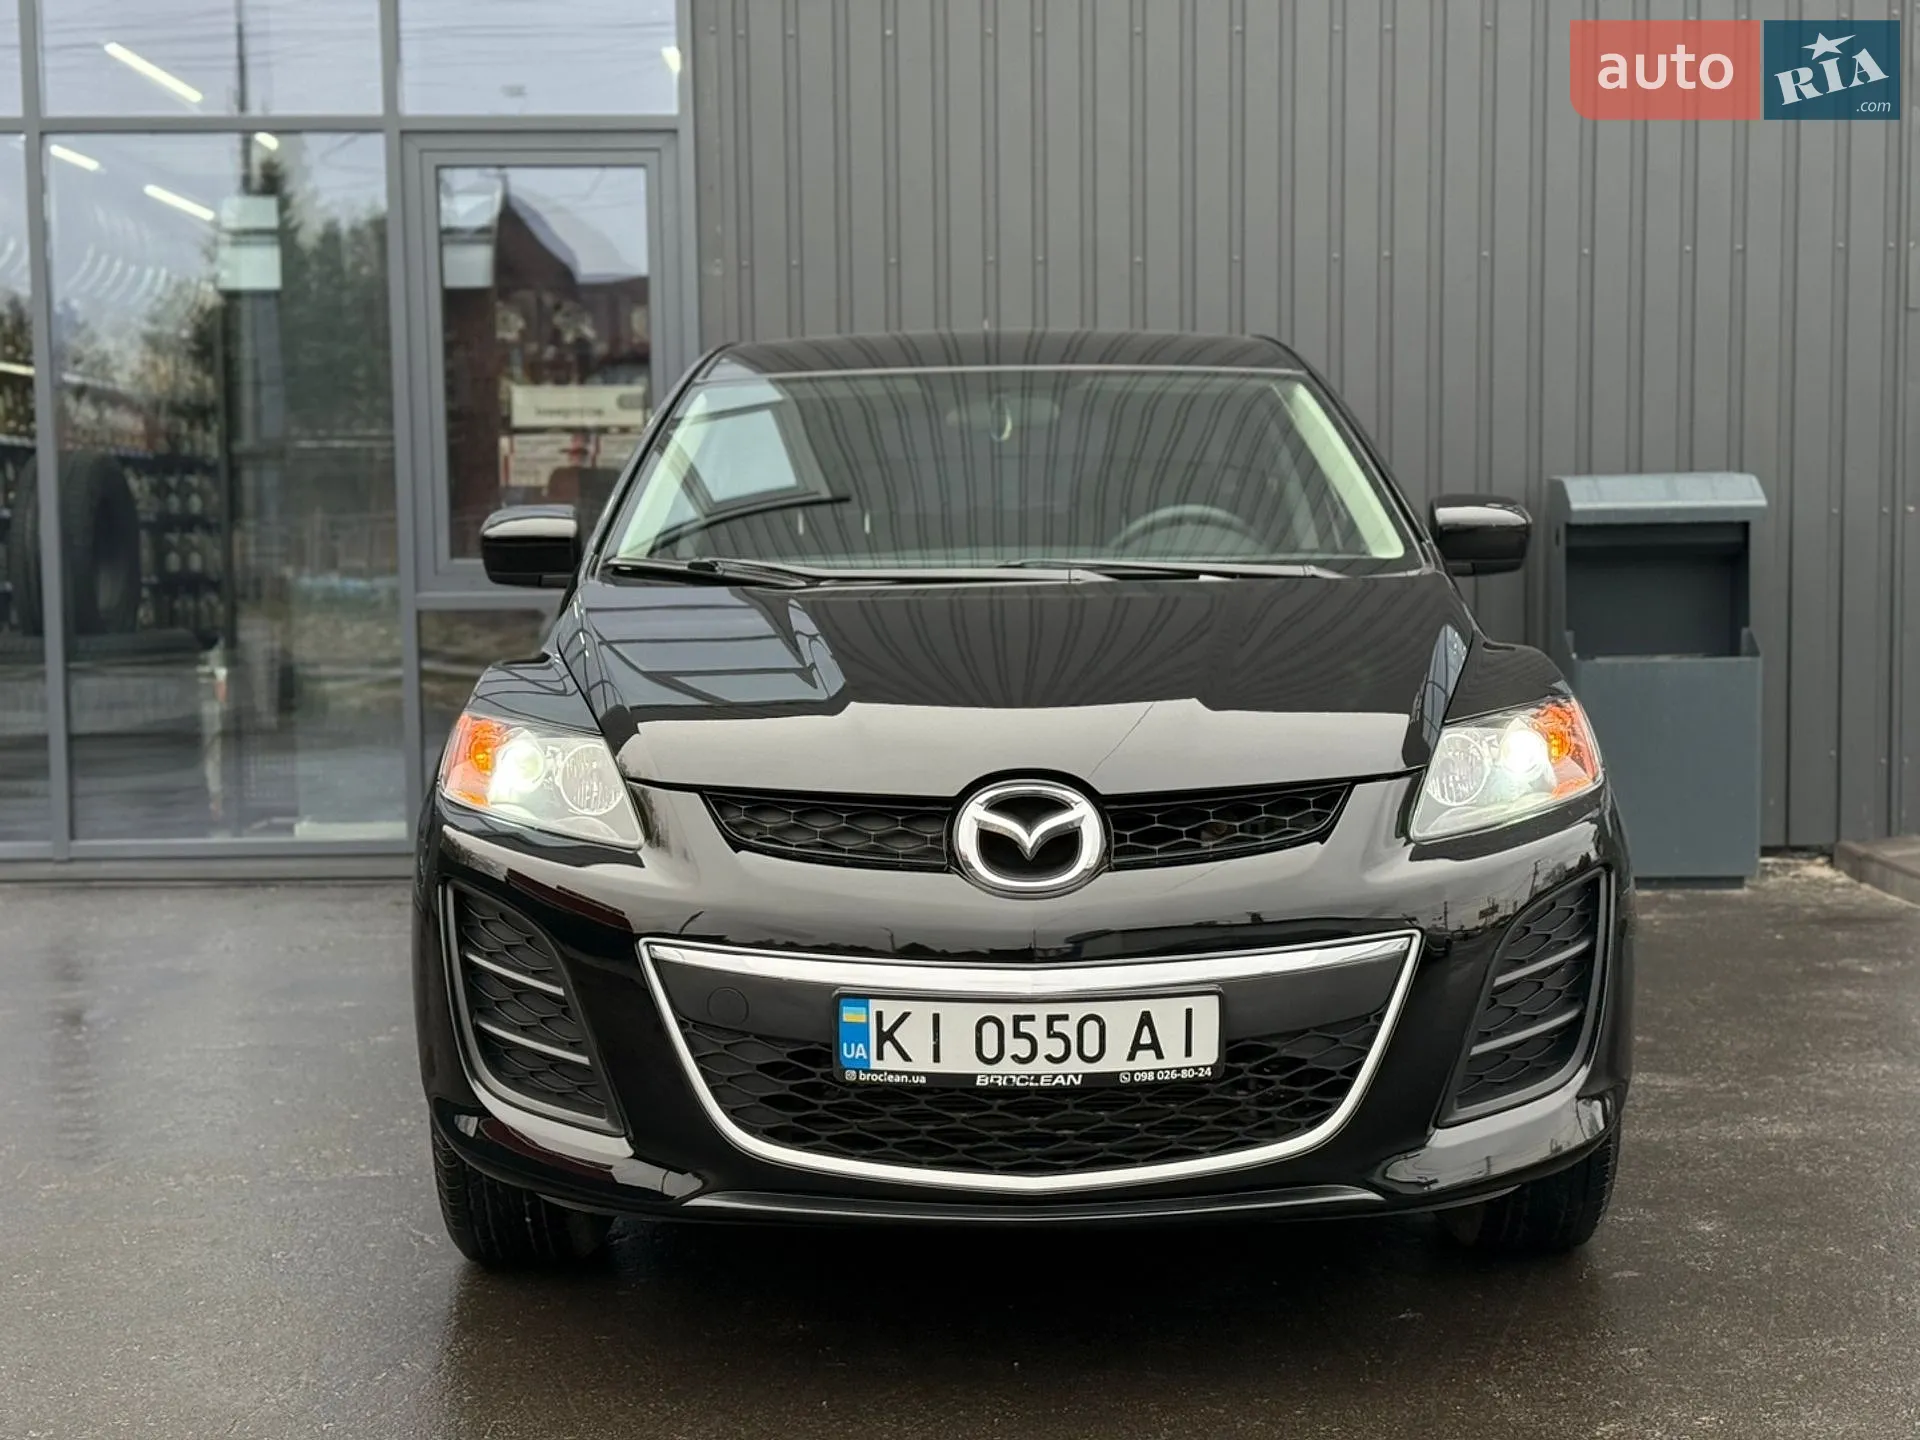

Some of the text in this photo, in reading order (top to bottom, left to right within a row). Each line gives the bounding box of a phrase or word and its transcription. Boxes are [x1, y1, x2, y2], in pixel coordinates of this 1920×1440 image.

[874, 1007, 1194, 1066] KI 0550 AI
[842, 1041, 869, 1060] UA
[858, 1070, 927, 1084] broclean.ua
[975, 1074, 1083, 1087] BROCLEAN
[1133, 1066, 1212, 1083] 098 026-80-24
